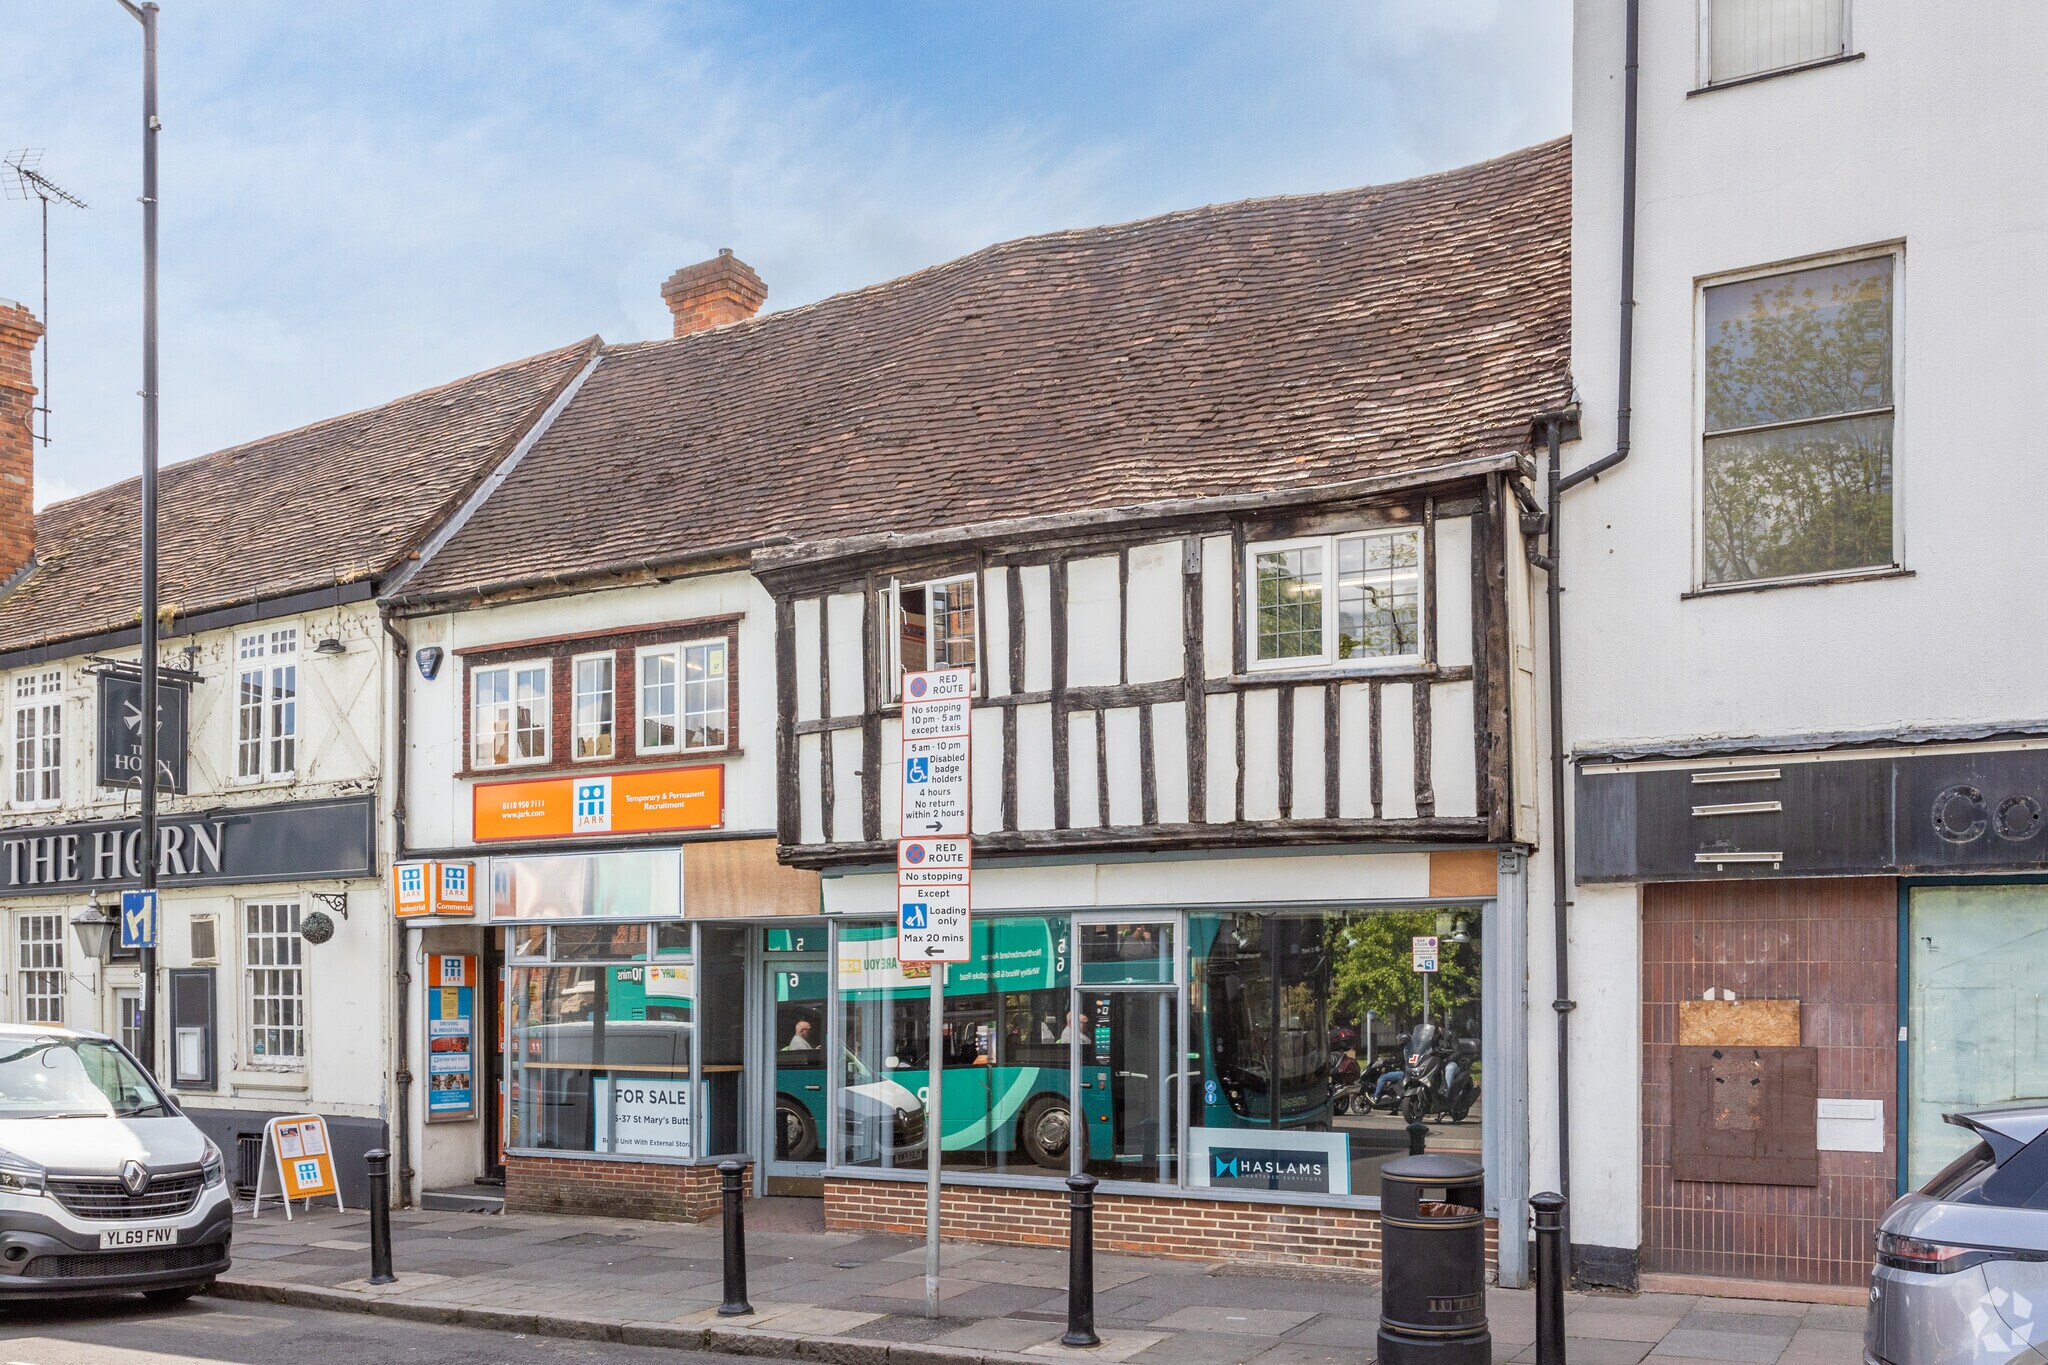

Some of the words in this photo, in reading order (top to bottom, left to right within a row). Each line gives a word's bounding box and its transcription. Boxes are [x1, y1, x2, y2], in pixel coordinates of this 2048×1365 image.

[939, 675, 957, 684] RED
[933, 684, 963, 695] ROUTE
[912, 706, 923, 714] No
[926, 703, 961, 713] stopping
[912, 716, 921, 724] 10
[923, 716, 935, 725] pm
[942, 714, 947, 722] 5
[911, 725, 938, 734] except
[942, 723, 961, 732] taxis
[912, 744, 917, 752] 5
[919, 744, 930, 752] am
[937, 742, 946, 750] 10
[948, 742, 961, 750] pm
[930, 753, 965, 763] Disabled
[115, 754, 171, 774] HON
[935, 765, 959, 773] badge
[932, 774, 962, 783] holders
[625, 794, 661, 803] Temporary
[662, 792, 667, 800] &
[669, 790, 705, 800] Permanent
[502, 801, 517, 810] 0118
[518, 800, 529, 809] 950
[531, 799, 545, 808] 7111
[644, 802, 685, 811] Recruitment
[915, 801, 926, 809] No
[929, 800, 955, 808] return
[502, 810, 545, 819] www.jark.com
[906, 810, 931, 819] within
[933, 810, 938, 818] 2
[579, 816, 605, 826] JARK
[936, 844, 957, 852] RED
[3, 834, 80, 885] THE
[929, 854, 964, 862] ROUTE
[906, 873, 919, 881] No
[922, 872, 963, 882] stopping
[403, 891, 421, 899] JARK
[918, 890, 950, 899] Except
[400, 904, 426, 913] Industrial
[437, 902, 474, 911] Commercial
[930, 907, 967, 916] Loading
[938, 917, 958, 926] only
[904, 934, 924, 943] Max
[927, 934, 940, 942] 20
[942, 934, 964, 942] mins
[616, 1088, 644, 1104] FOR
[649, 1090, 686, 1105] SALE
[633, 1115, 642, 1124] St
[644, 1116, 670, 1126] Mary's
[634, 1138, 649, 1146] With
[1241, 1160, 1322, 1176] HASLAMS
[108, 1230, 143, 1246] YL69
[147, 1228, 172, 1243] FNV
